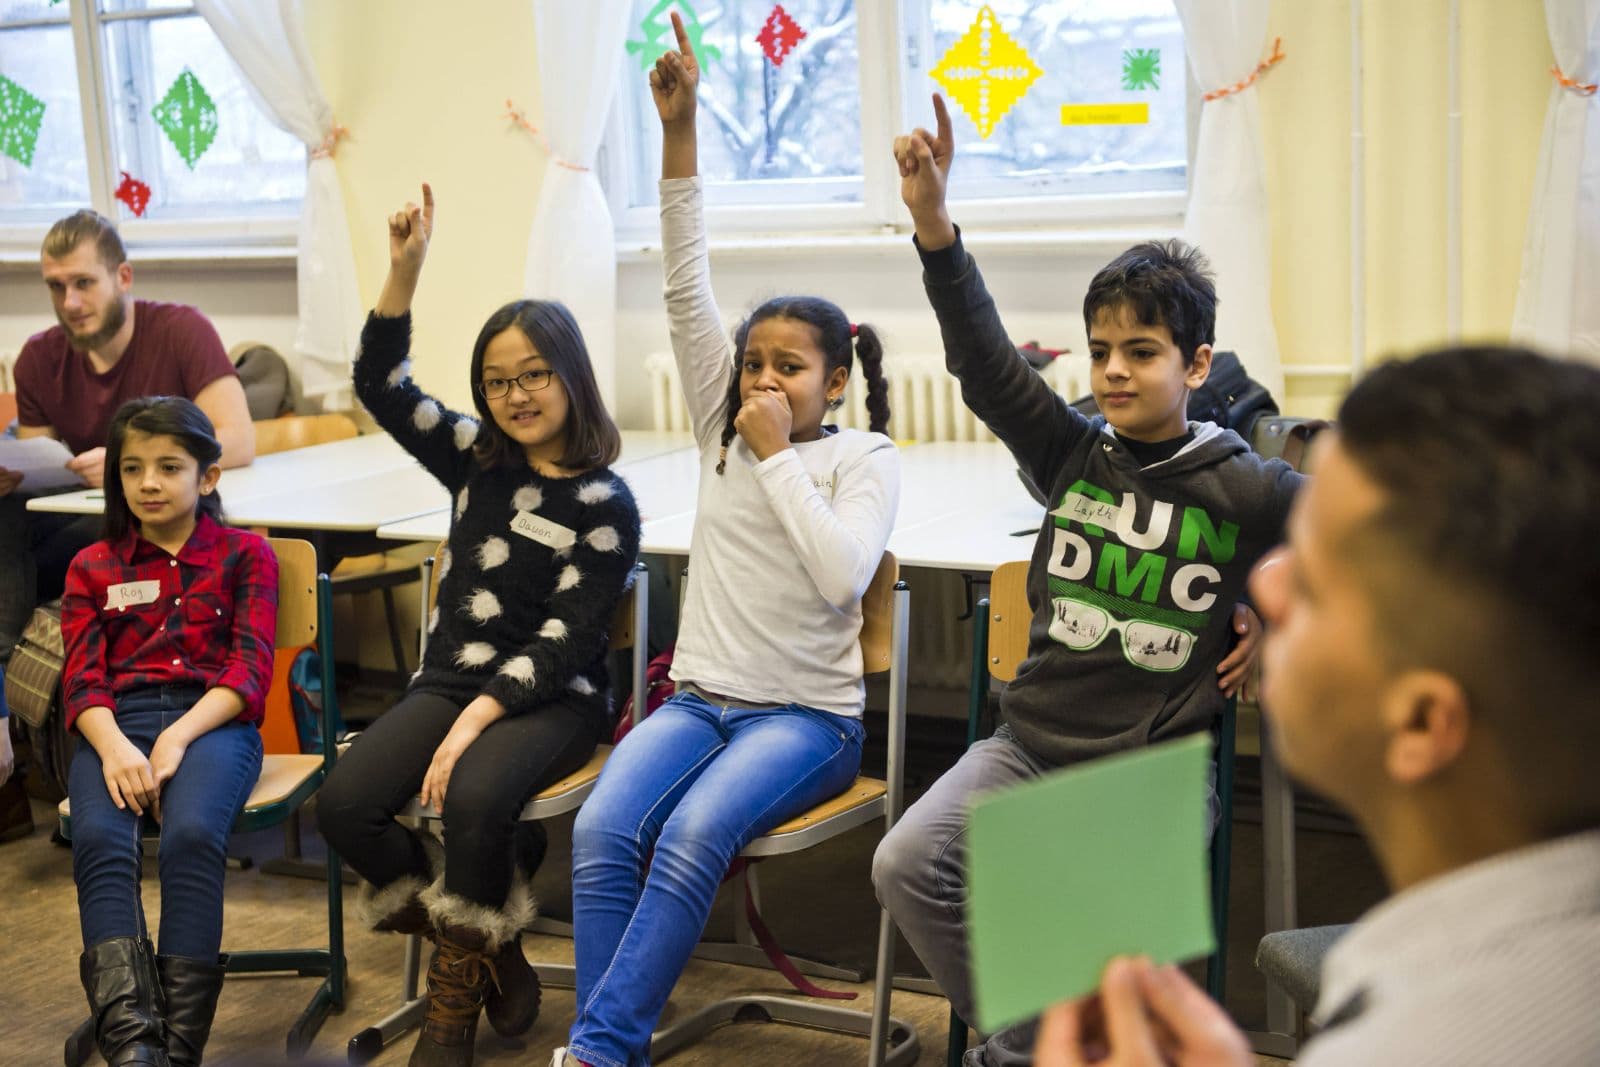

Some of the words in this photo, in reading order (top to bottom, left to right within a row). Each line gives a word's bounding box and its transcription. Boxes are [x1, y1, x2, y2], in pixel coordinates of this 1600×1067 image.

[813, 475, 833, 488] ain
[1073, 498, 1112, 520] Layth
[1047, 527, 1222, 612] DMC
